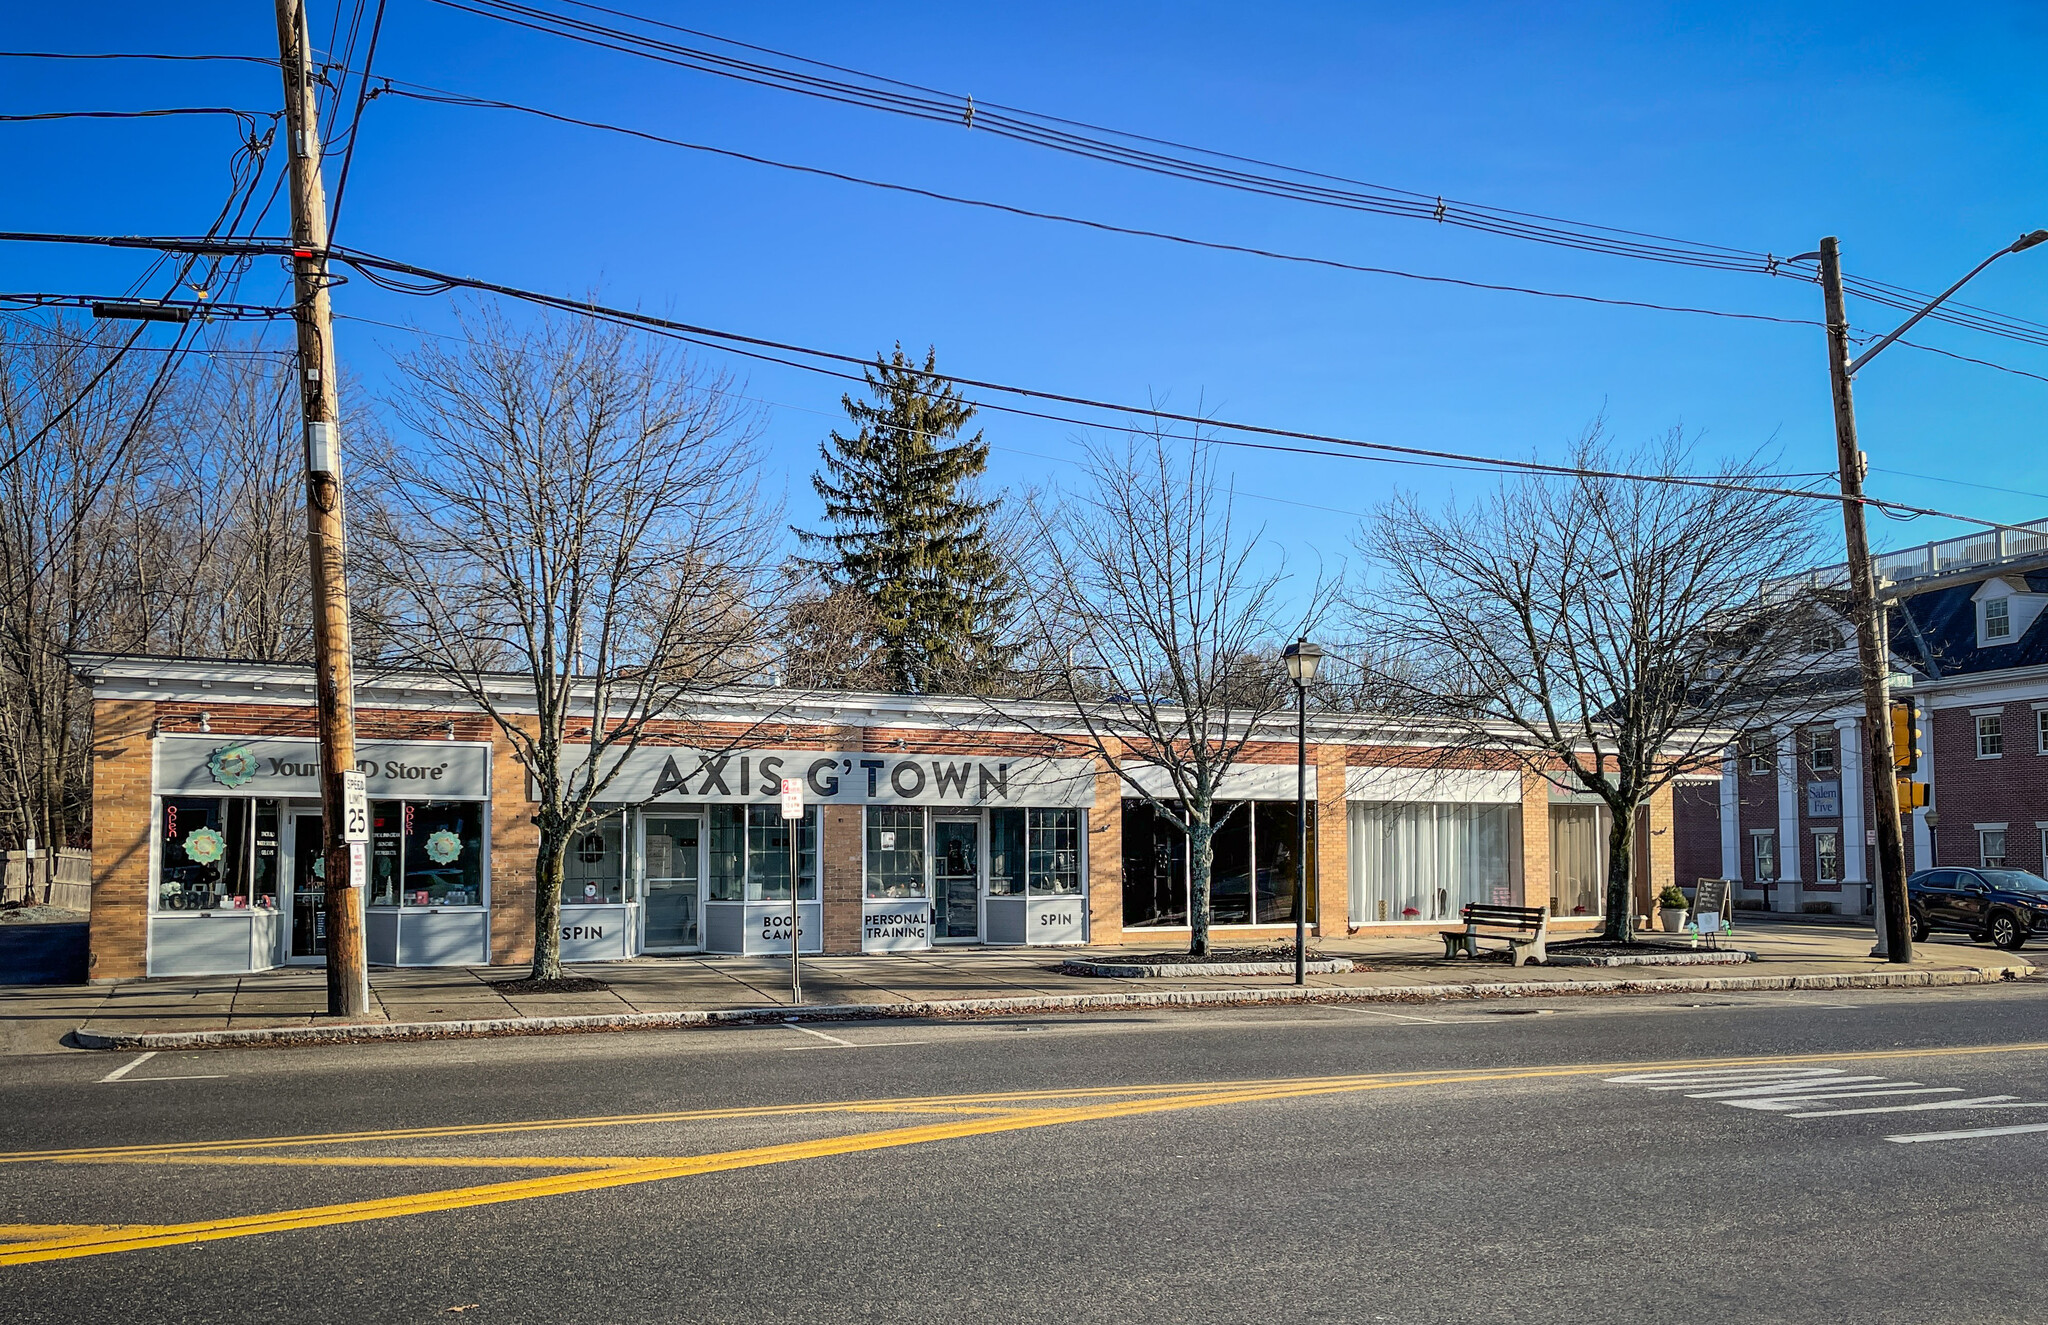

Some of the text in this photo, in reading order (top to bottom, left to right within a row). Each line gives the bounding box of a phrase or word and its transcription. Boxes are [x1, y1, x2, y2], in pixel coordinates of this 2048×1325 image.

[268, 757, 321, 777] Your
[651, 754, 1008, 800] AXIS G'TOWN
[346, 779, 365, 791] SPEED
[1809, 786, 1837, 799] Salem
[348, 793, 363, 806] LIMIT
[1814, 800, 1833, 812] Five
[348, 808, 366, 834] 25
[763, 916, 801, 927] BOOT
[865, 914, 927, 926] PERSONAL
[1040, 914, 1072, 926] SPIN
[562, 926, 603, 940] SPIN
[762, 929, 803, 940] CAMP
[867, 927, 925, 939] TRAINING
